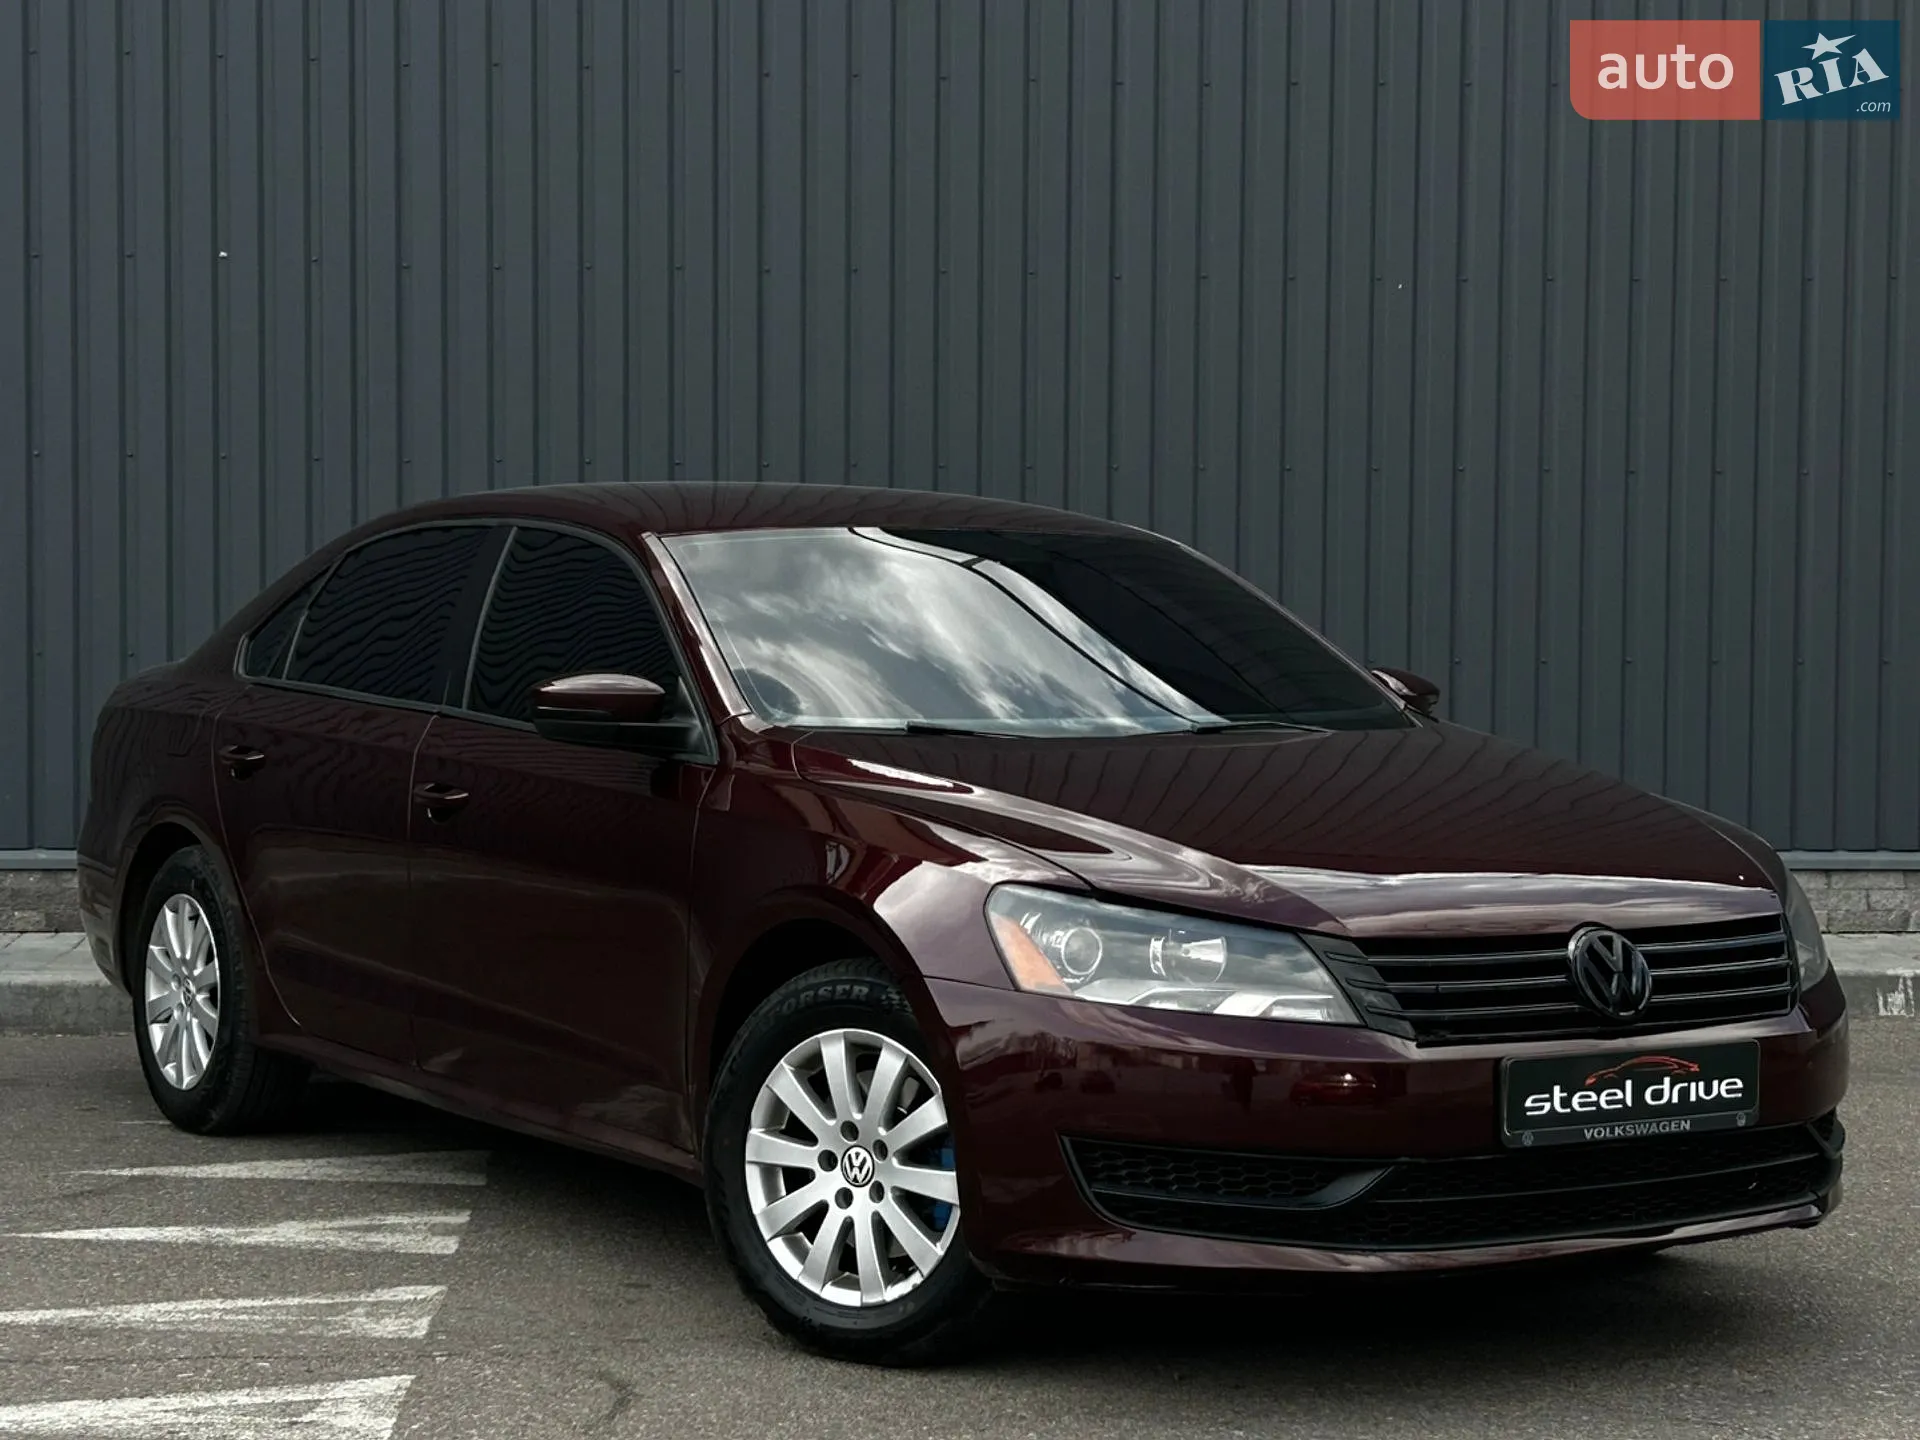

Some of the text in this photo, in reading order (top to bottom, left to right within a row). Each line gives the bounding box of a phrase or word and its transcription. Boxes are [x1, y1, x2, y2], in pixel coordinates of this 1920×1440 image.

[1524, 1076, 1744, 1116] steel drive
[1583, 1119, 1691, 1140] VOLKSWAGEN
